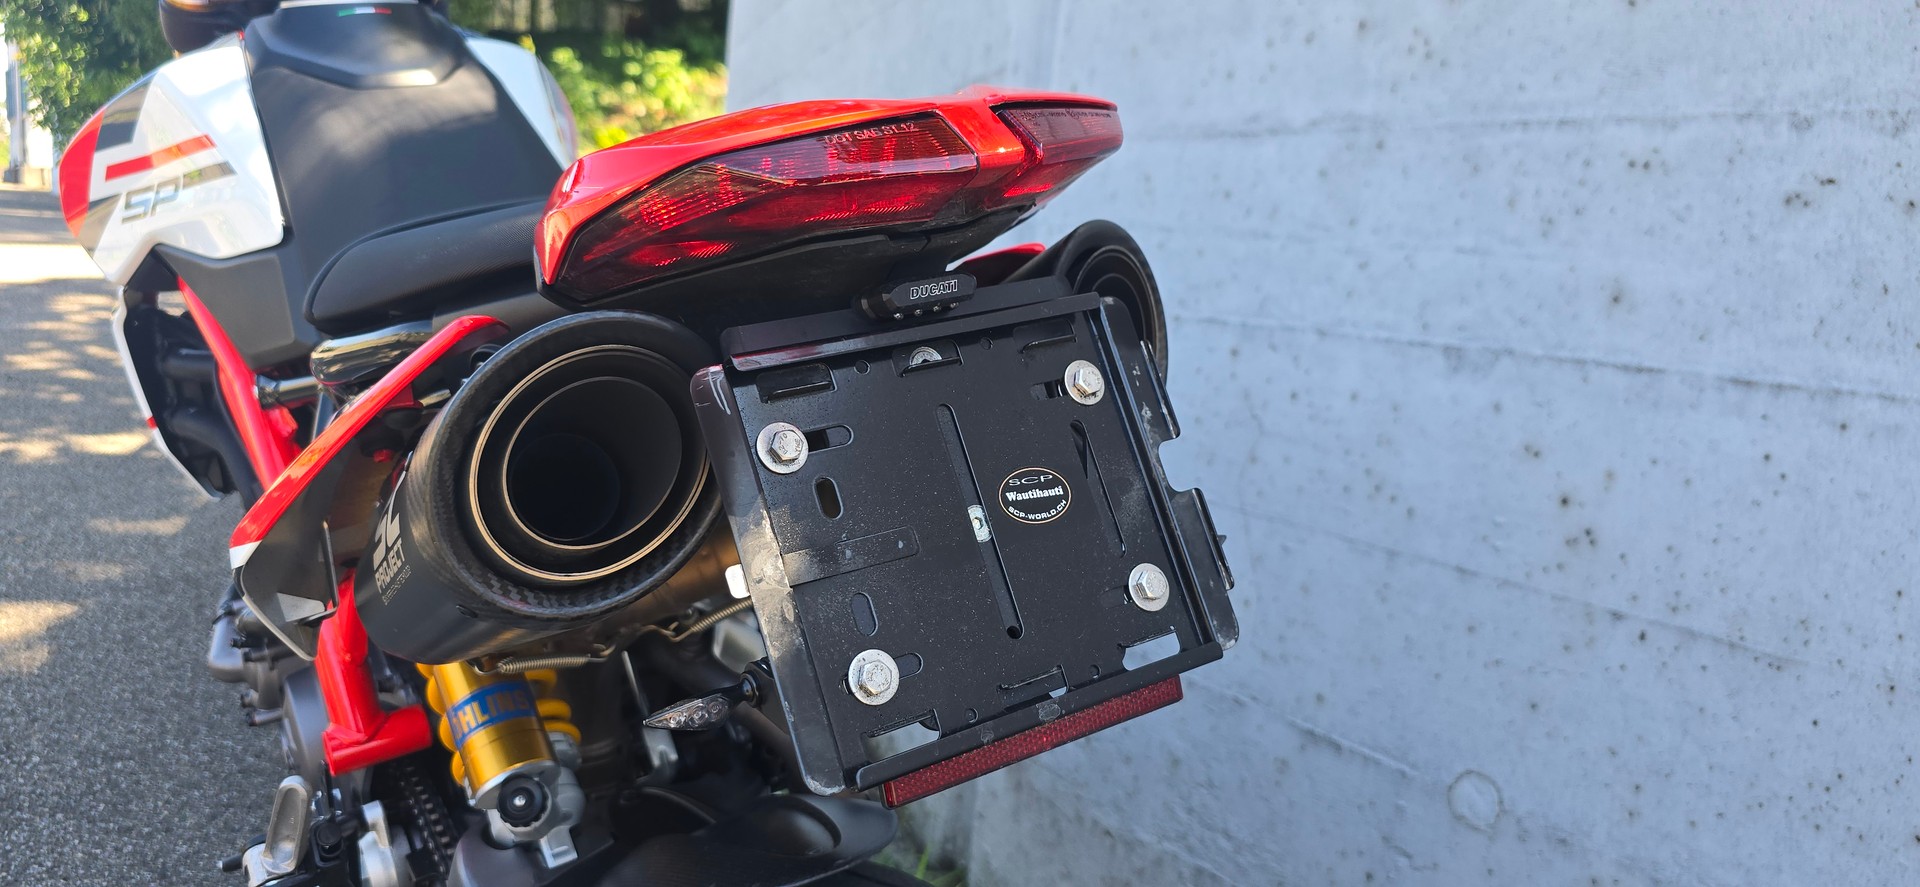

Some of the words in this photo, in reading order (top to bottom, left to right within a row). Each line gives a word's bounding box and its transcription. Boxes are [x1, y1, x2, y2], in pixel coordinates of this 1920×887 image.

[121, 177, 181, 225] SP
[910, 279, 958, 300] DUCATI
[1008, 474, 1053, 486] SCP
[1005, 485, 1064, 502] Wautihauti
[1008, 499, 1067, 520] SCP-WORLD.CH
[374, 537, 405, 594] PROJECT
